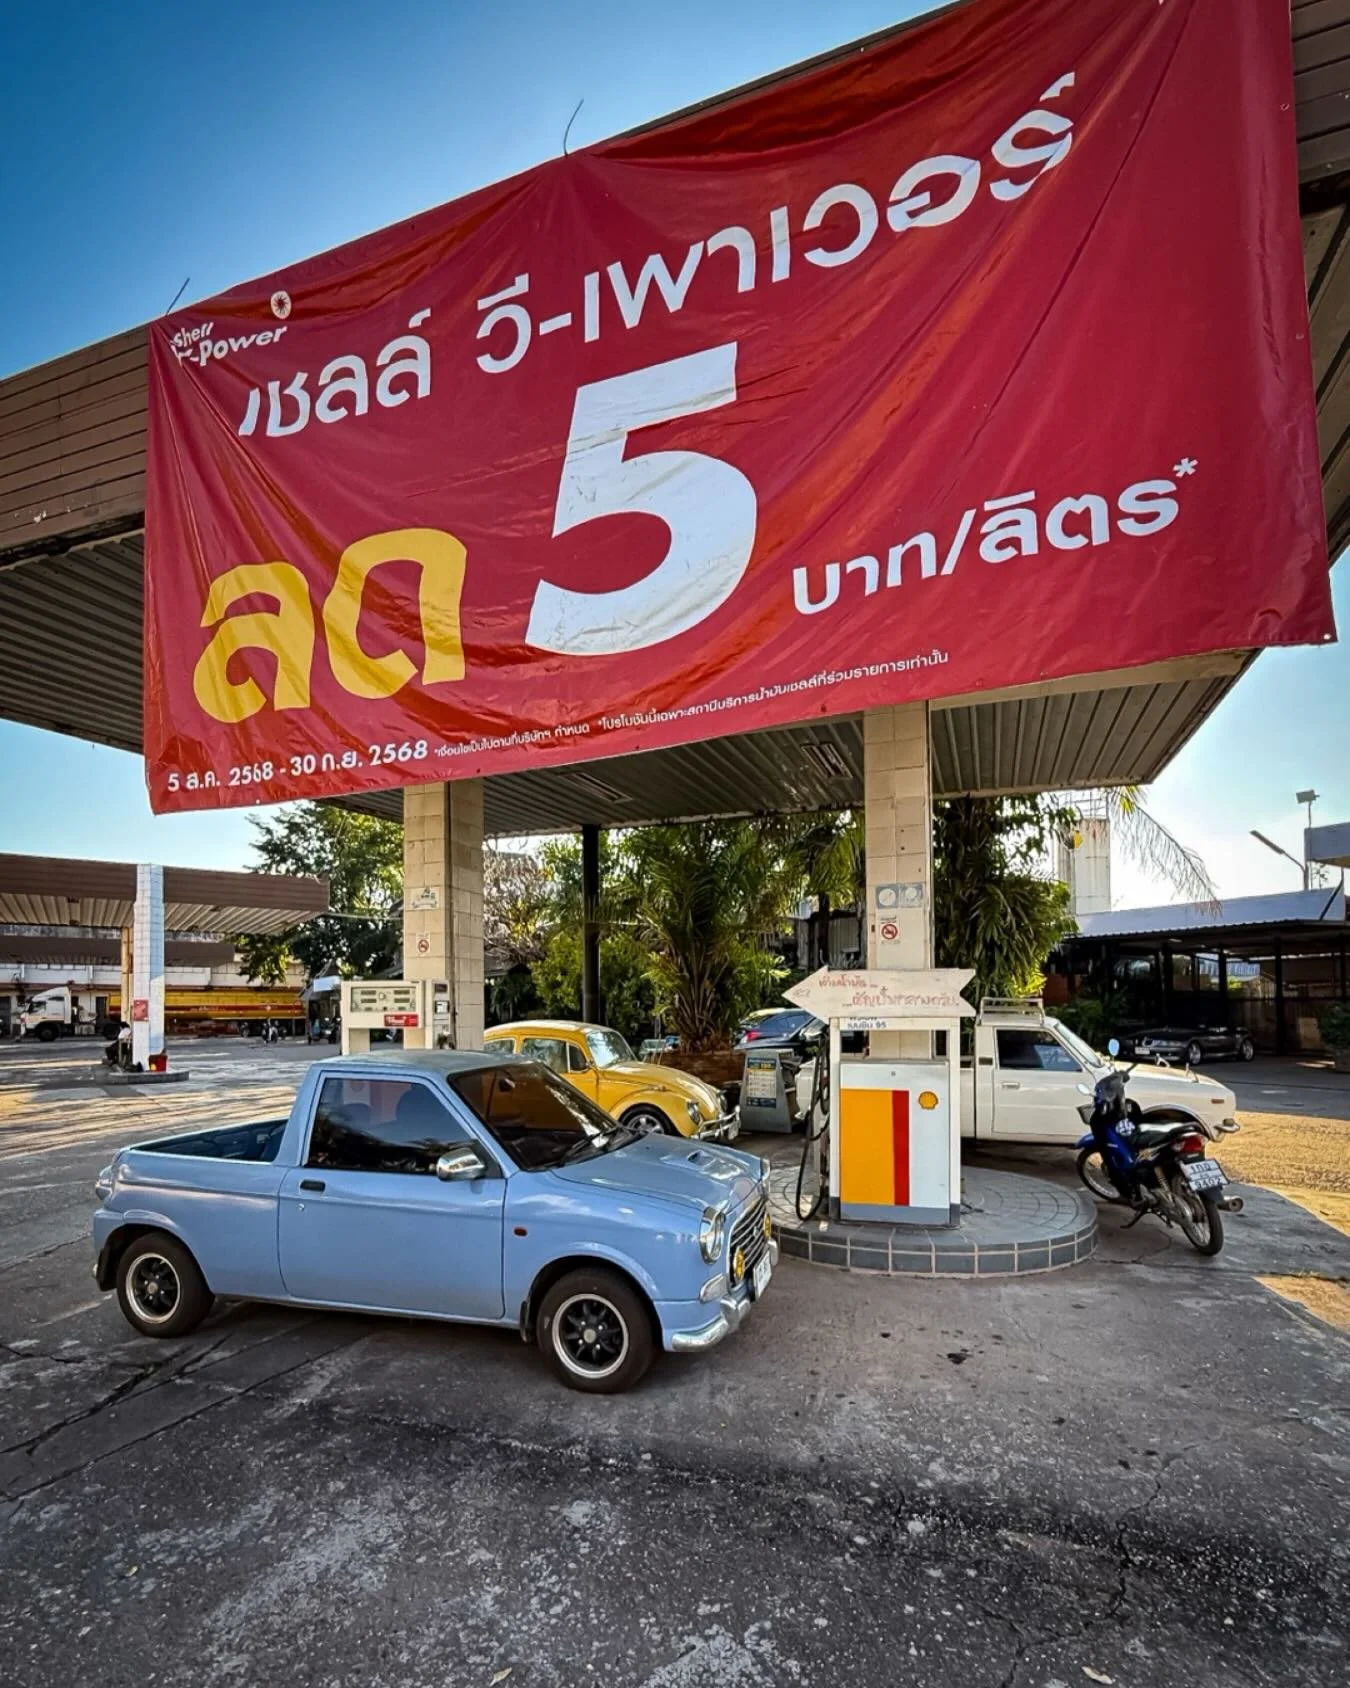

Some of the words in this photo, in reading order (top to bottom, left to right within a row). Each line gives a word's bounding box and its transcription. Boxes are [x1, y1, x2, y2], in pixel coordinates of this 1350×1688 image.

[238, 308, 431, 438] เชลล์
[476, 71, 1075, 374] วี-เพาเวอร์
[194, 529, 467, 724] ลด
[525, 343, 758, 657] 5
[167, 773, 180, 792] 5
[186, 771, 221, 790] ส.ค.
[228, 762, 274, 786] 2568
[291, 755, 317, 776] 30
[321, 751, 363, 772] ก.ย.
[369, 740, 428, 766] 2568
[554, 722, 590, 737] กำหนด
